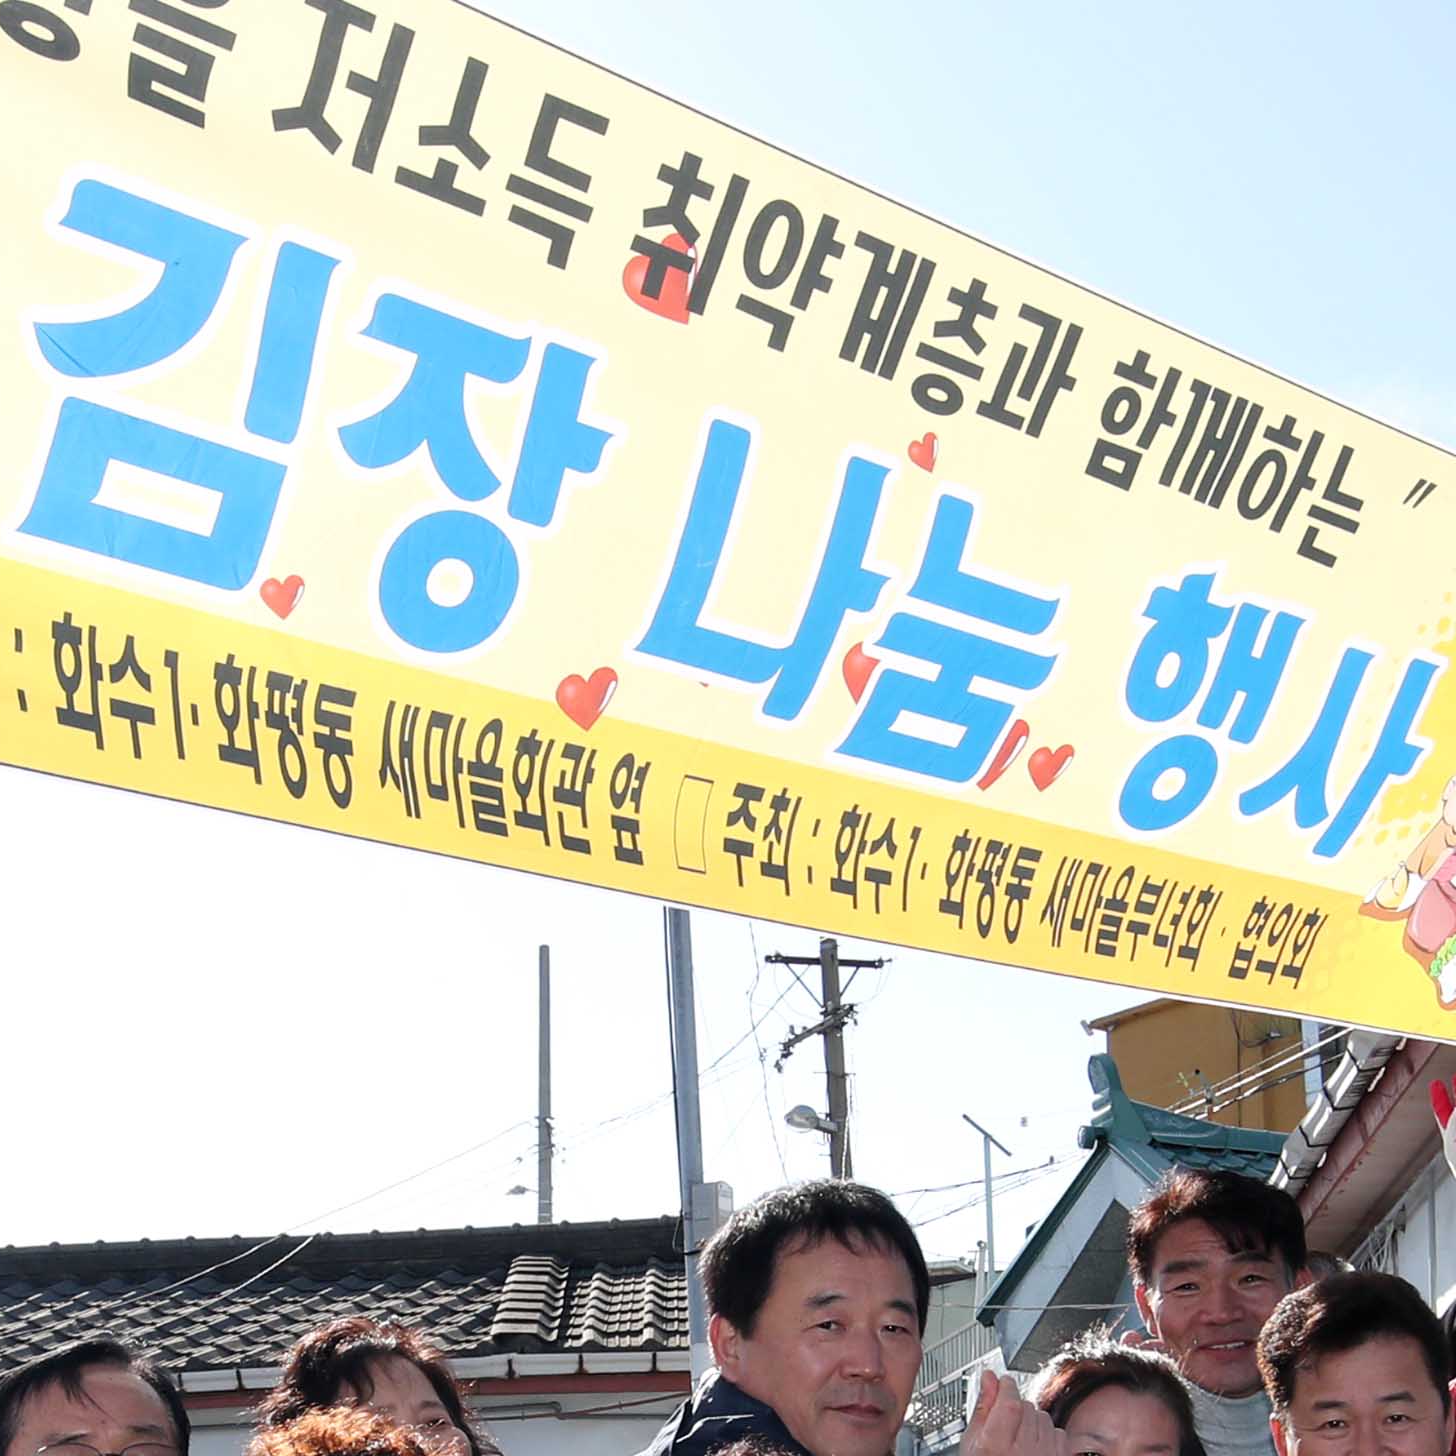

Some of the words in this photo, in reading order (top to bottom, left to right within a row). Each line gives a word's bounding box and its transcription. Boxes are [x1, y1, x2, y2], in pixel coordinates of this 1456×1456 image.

[272, 0, 610, 270] 저소득
[630, 152, 1085, 438] 취약계층과
[1085, 350, 1364, 568] 함께하는
[17, 179, 614, 653] 김장
[635, 419, 1060, 783] 나눔
[1119, 572, 1439, 856] 행사
[378, 699, 595, 855] 새마을회관
[609, 752, 652, 866] 옆
[723, 782, 801, 897] 주최
